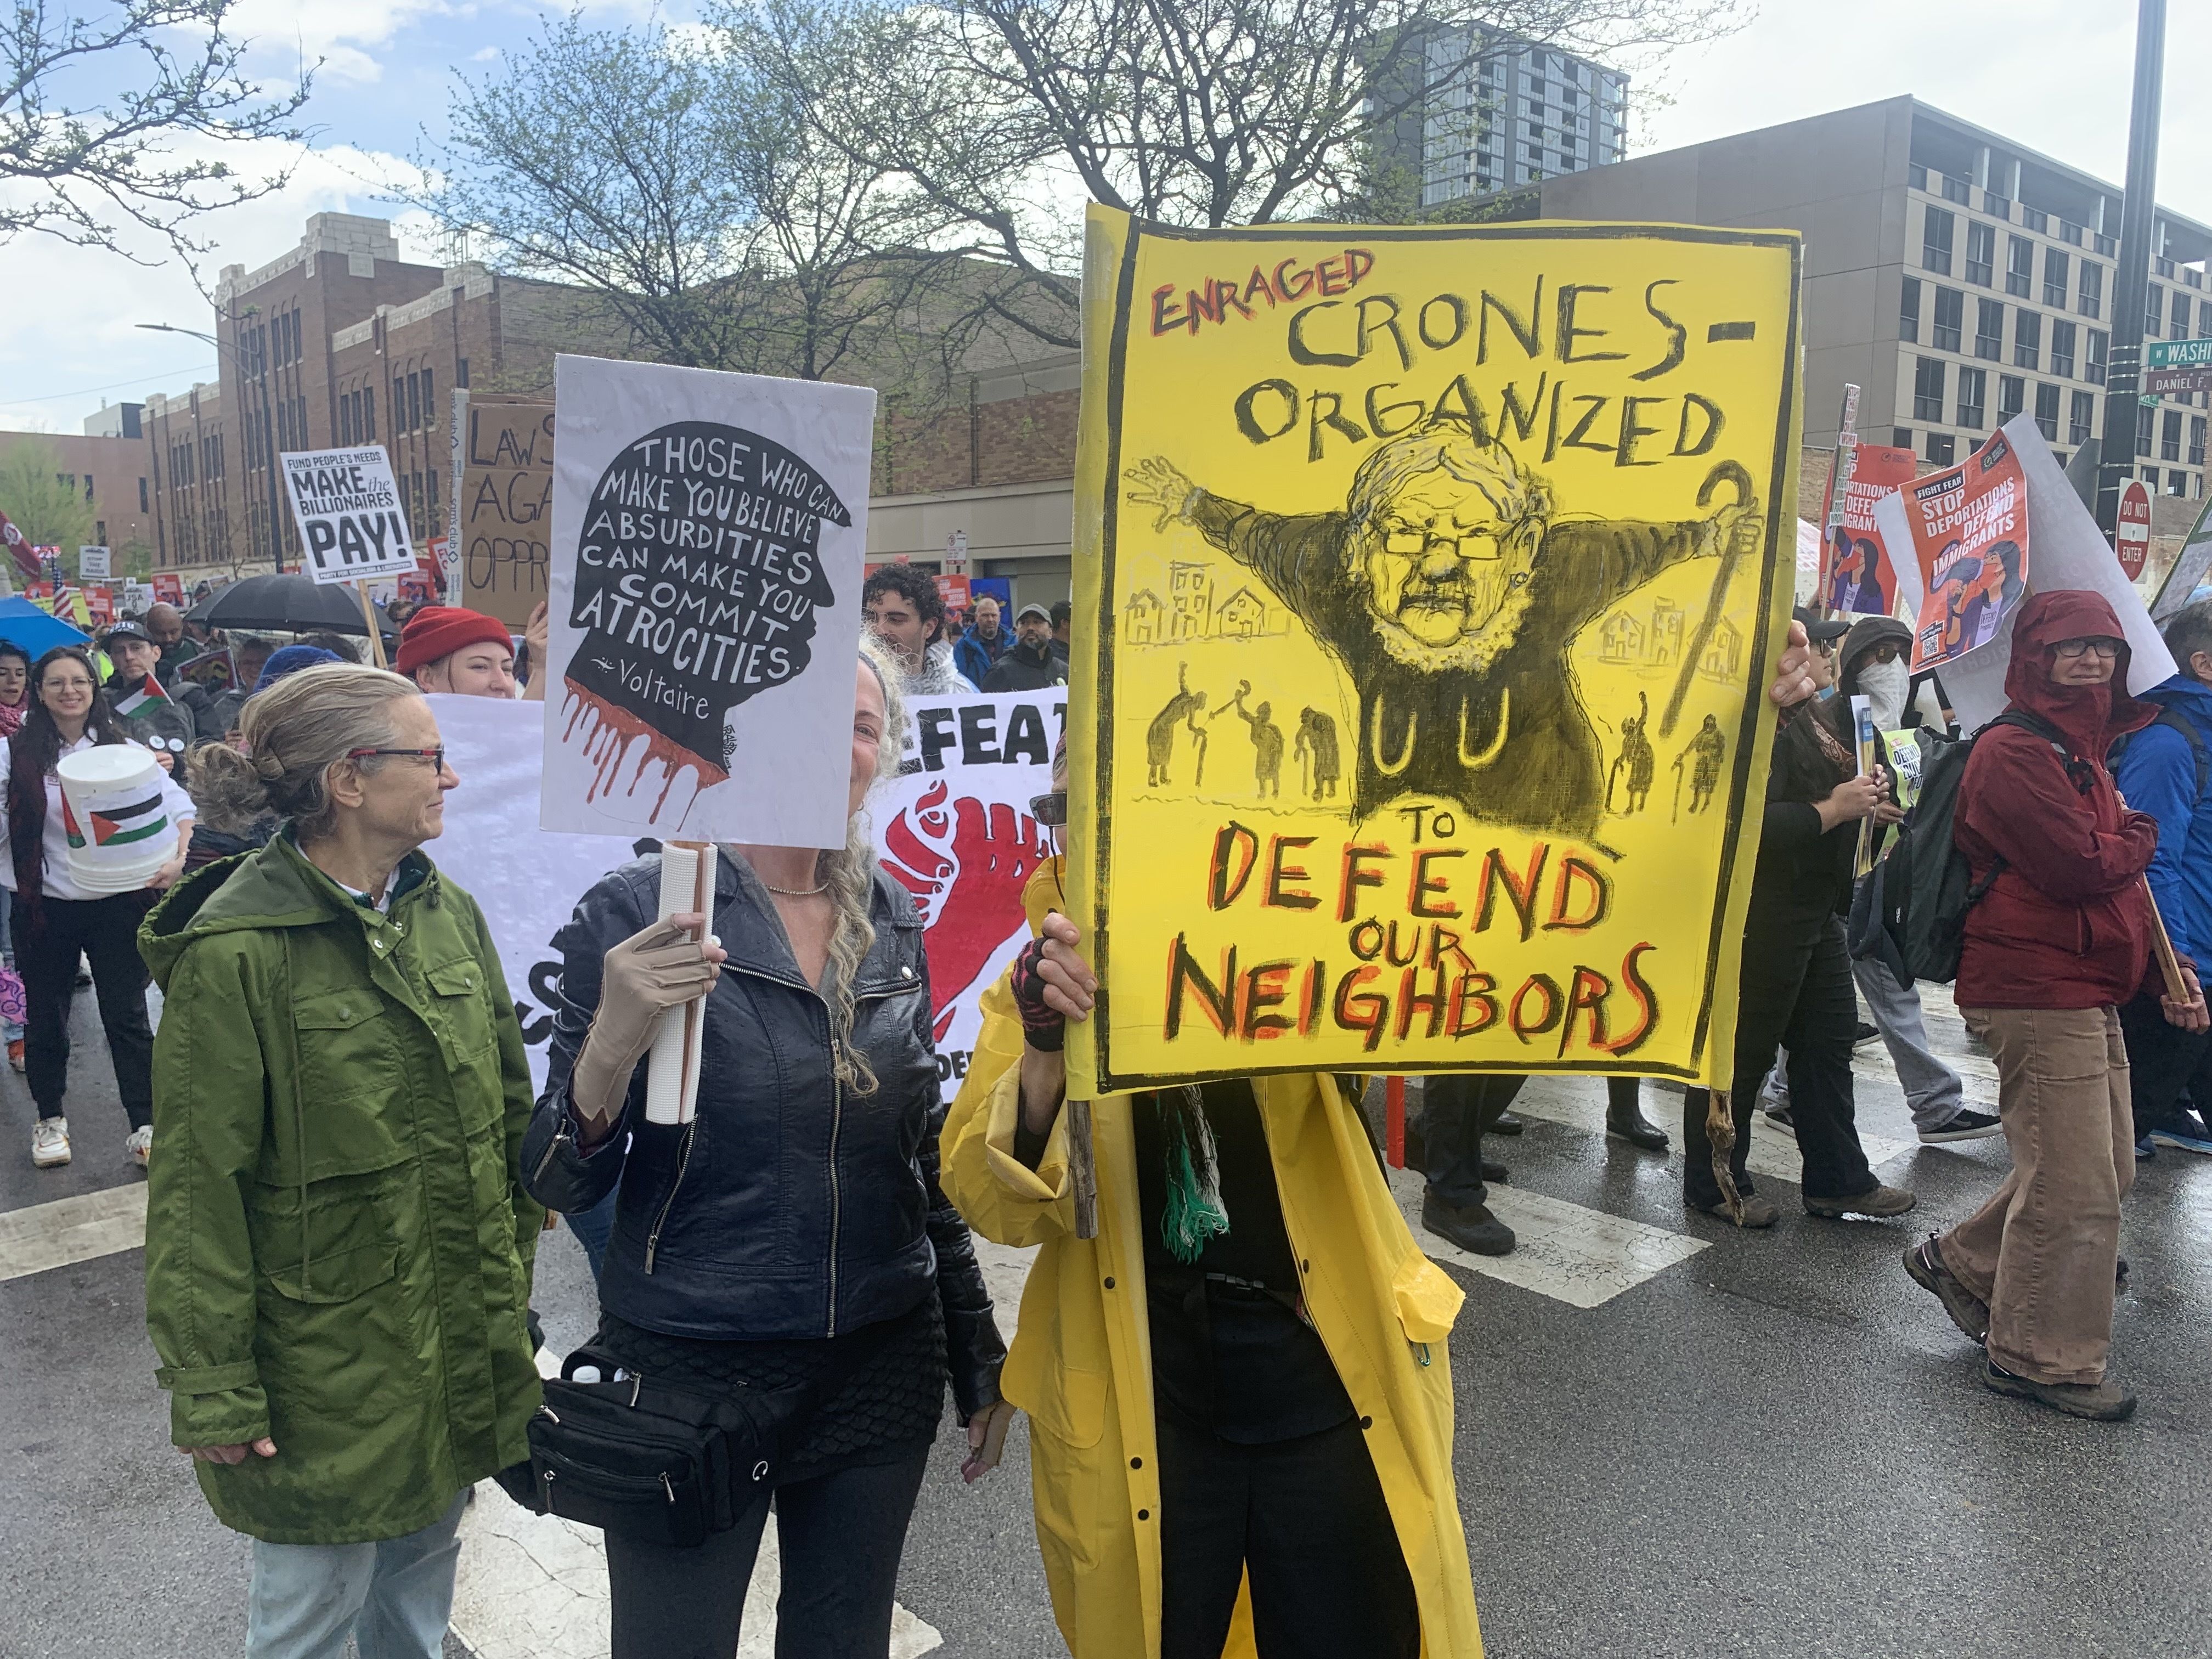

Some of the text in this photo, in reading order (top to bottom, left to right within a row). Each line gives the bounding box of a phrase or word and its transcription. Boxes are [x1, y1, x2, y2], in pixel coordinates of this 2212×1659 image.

[1151, 248, 1376, 338] ENRAGED
[2156, 349, 2163, 359] W
[2155, 377, 2193, 391] DANIEL
[1234, 370, 1726, 466] ORGANIZED
[287, 452, 382, 469] FUND PEOPLE'S NEEDS
[291, 466, 390, 500] MAKE the
[633, 437, 843, 521] THOSE WHO CAN
[1917, 477, 1962, 499] FIGHT FEAR
[299, 492, 394, 516] BILLIONAIRES
[600, 469, 816, 544] MAKE YOU BELIEVE
[1921, 489, 1965, 520] STOP
[1925, 476, 2015, 538] DEPORTATIONS
[1963, 493, 2015, 540] DEFEND
[2123, 500, 2148, 518] DO NOT
[305, 511, 408, 568] PAY!
[449, 528, 459, 549] club
[587, 510, 813, 585] ABSURDITIES
[1932, 514, 2015, 577] IMMIGRANTS
[2122, 546, 2142, 563] ENTER
[582, 544, 812, 622] CAN MAKE YOU
[619, 574, 789, 642] COMMIT
[619, 659, 709, 720] Voltaire
[1893, 744, 1920, 765] DEFEND
[1403, 805, 1456, 843] TO
[1208, 820, 1616, 943] DEFEND
[1349, 915, 1476, 970] OUR
[1164, 931, 1662, 1059] NEIGHBORS
